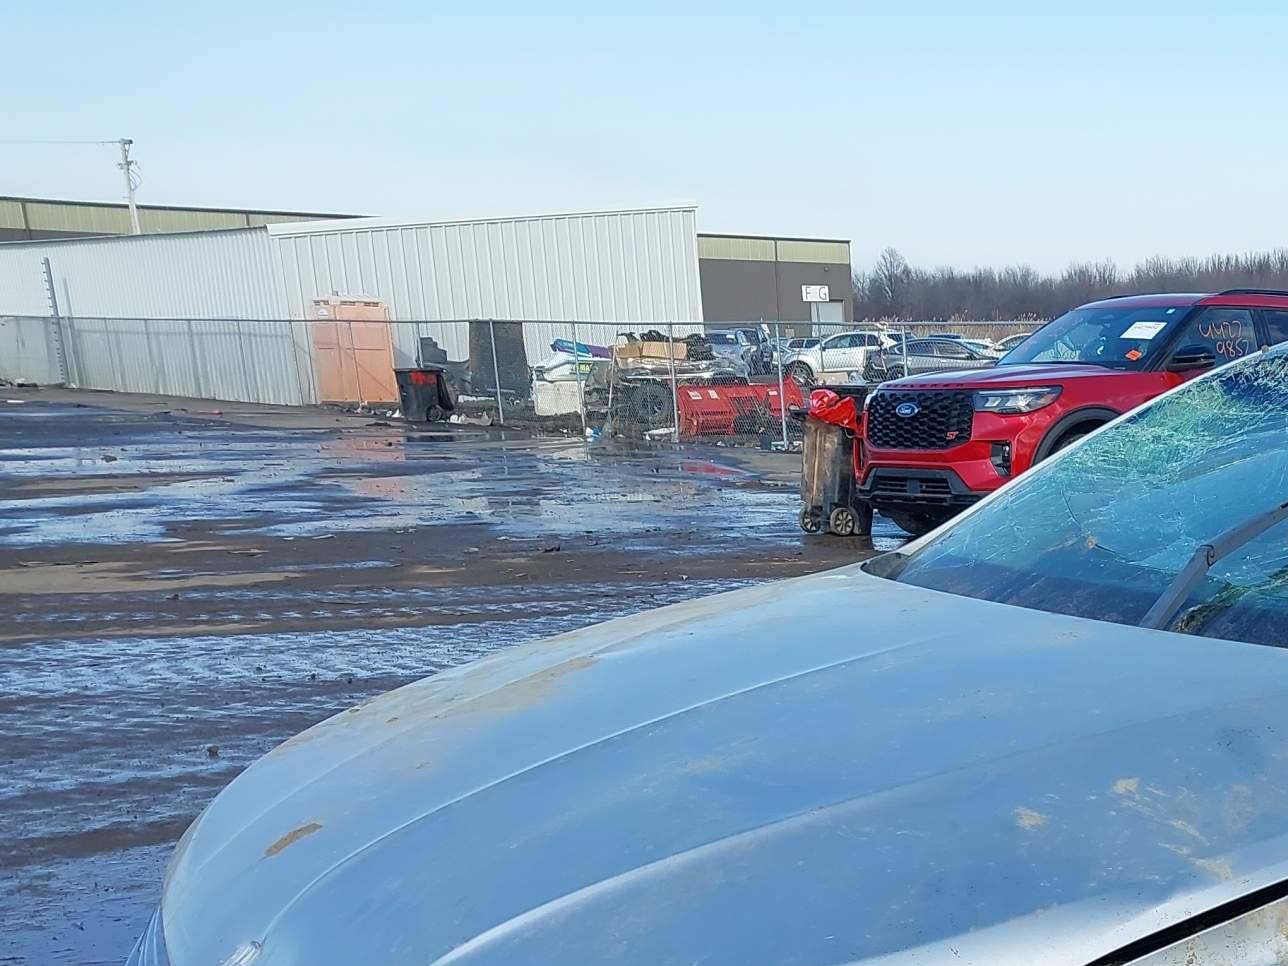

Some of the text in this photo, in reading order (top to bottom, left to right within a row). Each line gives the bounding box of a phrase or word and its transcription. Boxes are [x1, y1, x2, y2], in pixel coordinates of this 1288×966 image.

[805, 286, 828, 300] F G
[946, 431, 959, 439] ST
